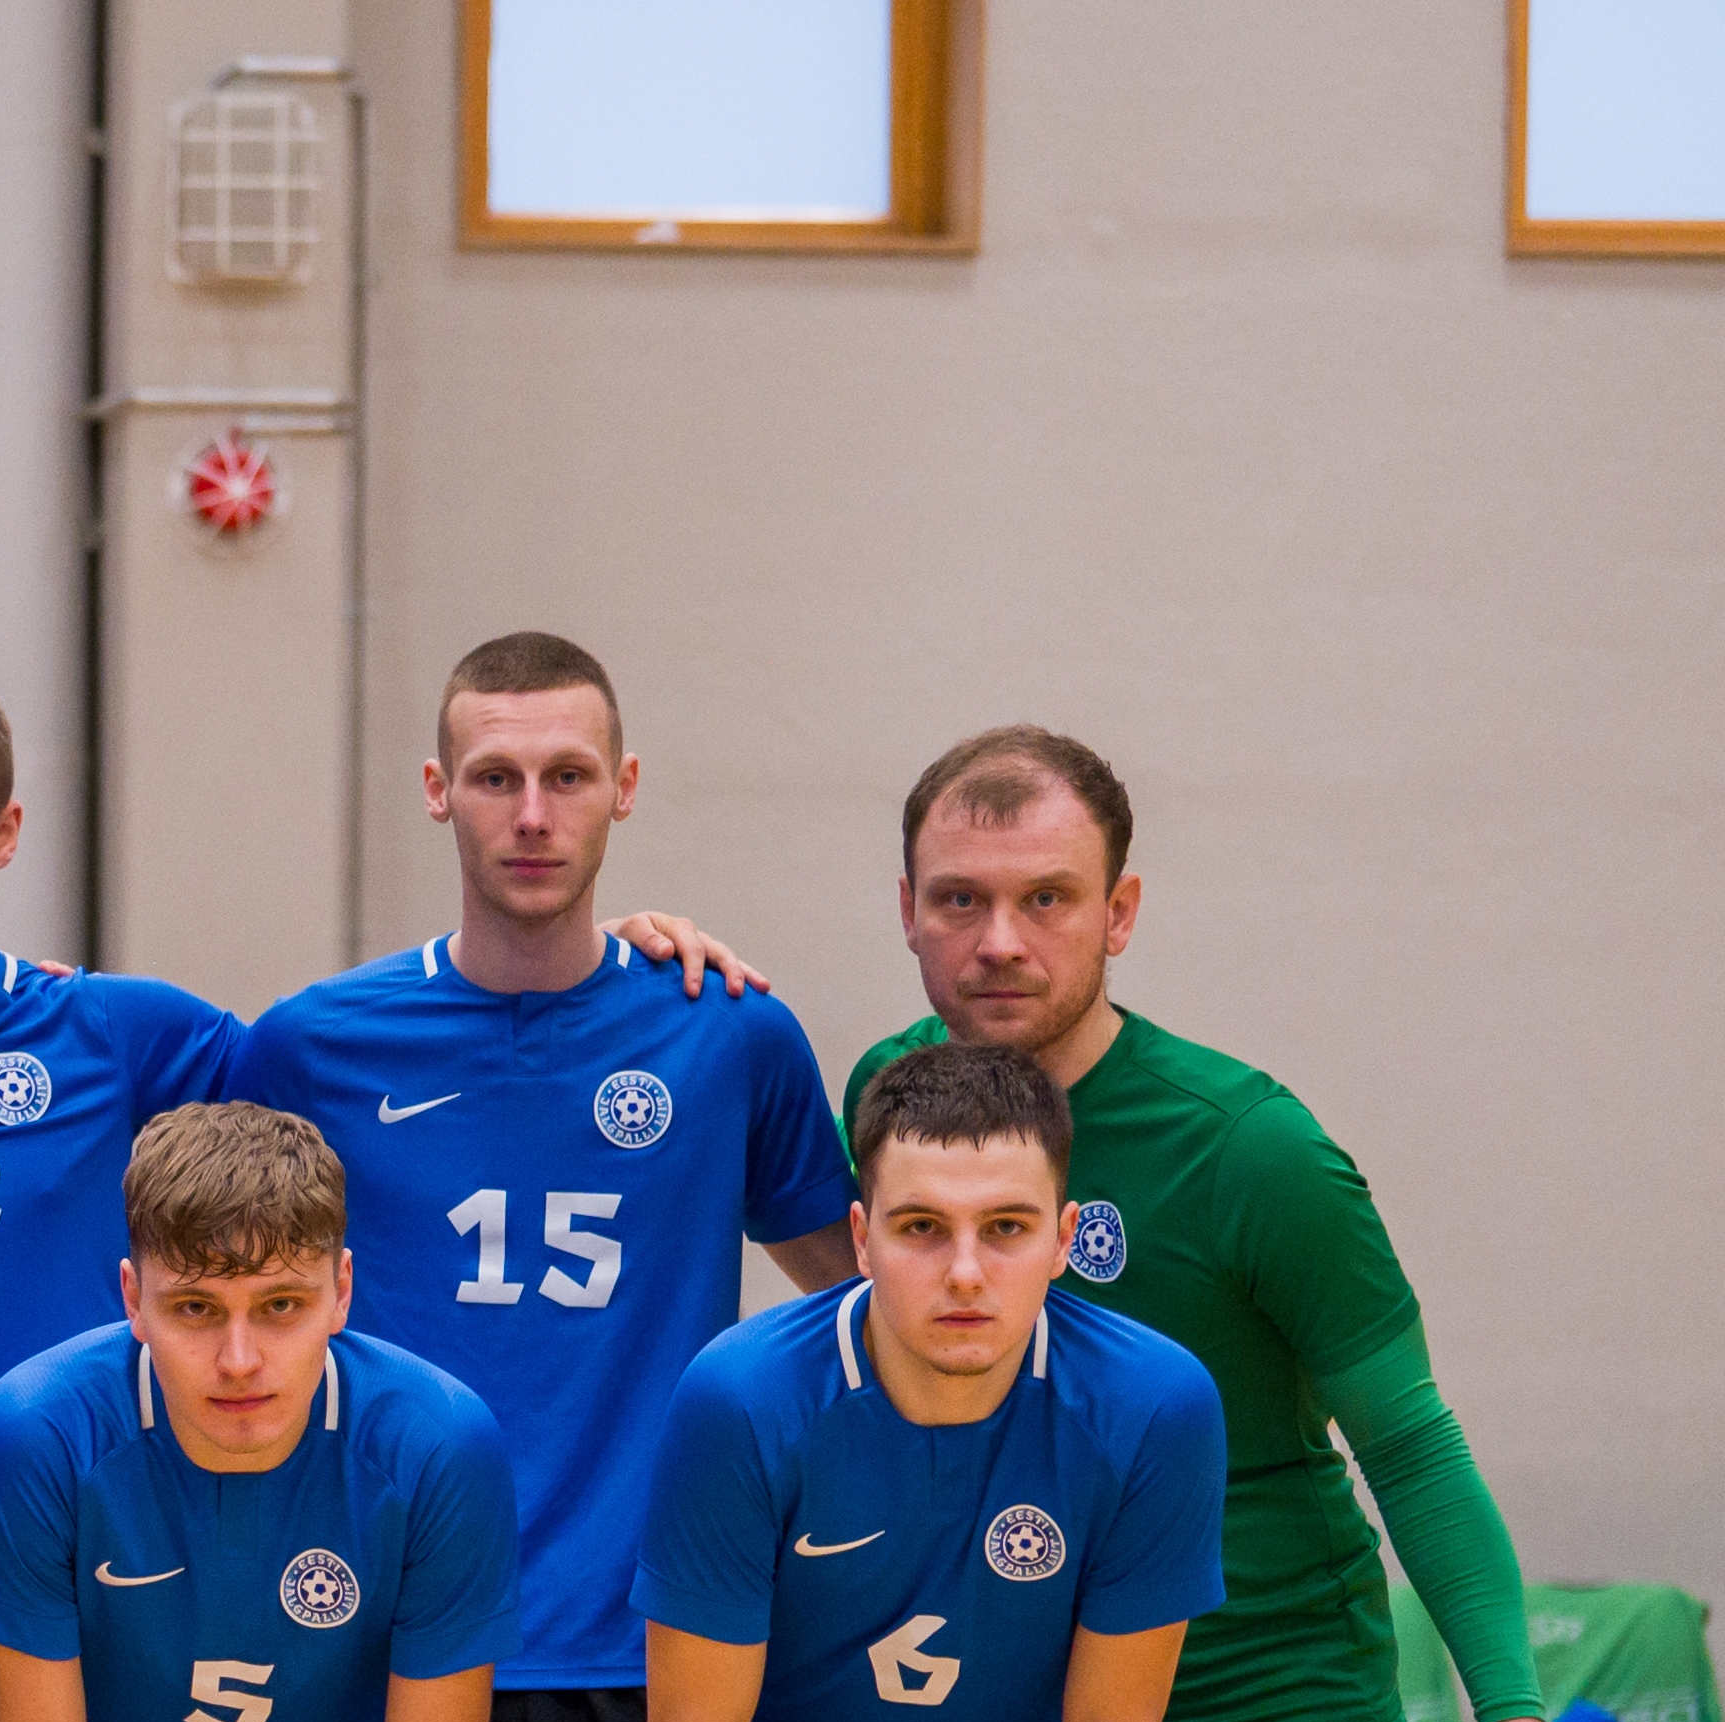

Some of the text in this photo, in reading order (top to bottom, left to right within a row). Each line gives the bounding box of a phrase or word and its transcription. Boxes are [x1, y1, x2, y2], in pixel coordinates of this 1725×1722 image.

[35, 1075, 47, 1105] LIIT
[600, 1076, 667, 1143] EESTI JALGPALLI LIIT
[447, 1189, 622, 1307] 15
[1084, 1207, 1119, 1226] EESTI
[1069, 1229, 1116, 1277] LGPALLI
[990, 1510, 1060, 1575] EESTI JALGPALLI LIIT
[285, 1555, 355, 1623] EESTI JALGPALLI LIIT
[868, 1615, 960, 1705] 6
